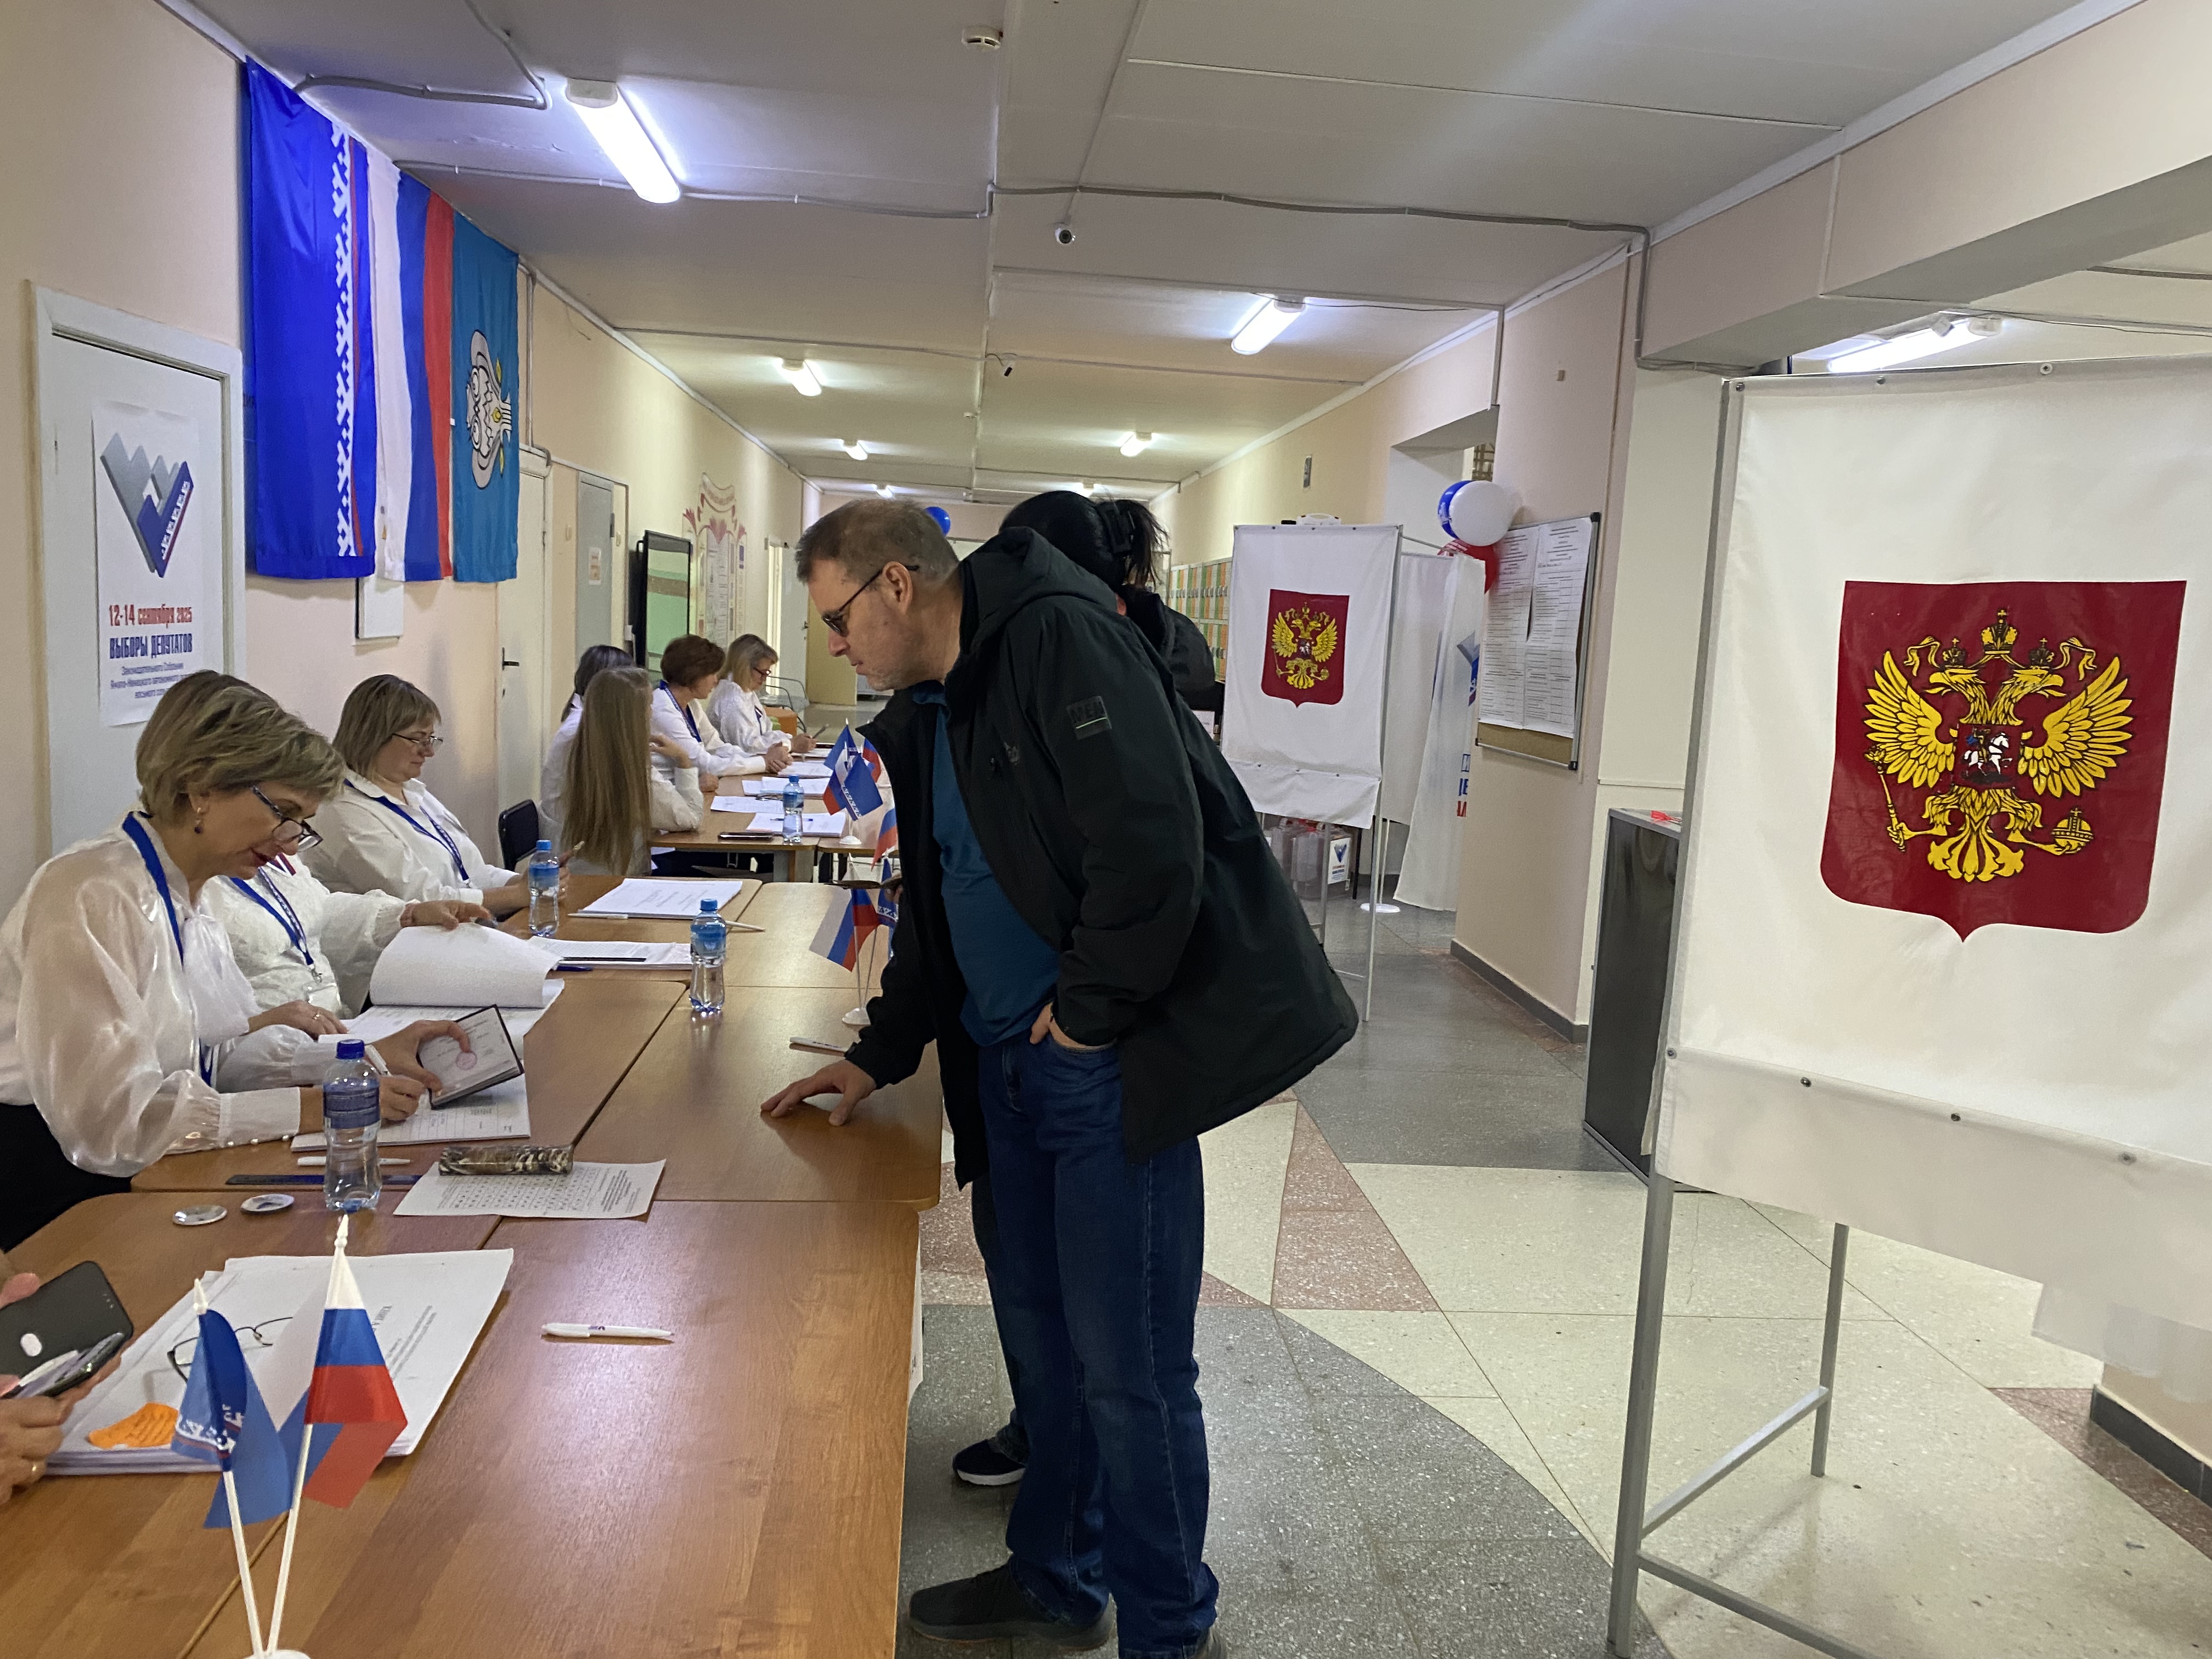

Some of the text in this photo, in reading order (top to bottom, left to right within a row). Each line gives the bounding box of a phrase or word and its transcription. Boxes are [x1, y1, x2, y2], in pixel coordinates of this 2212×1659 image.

[109, 605, 135, 626] 12-14
[110, 633, 192, 659] ВЫБОРЫ ДЕПУТАТОВ
